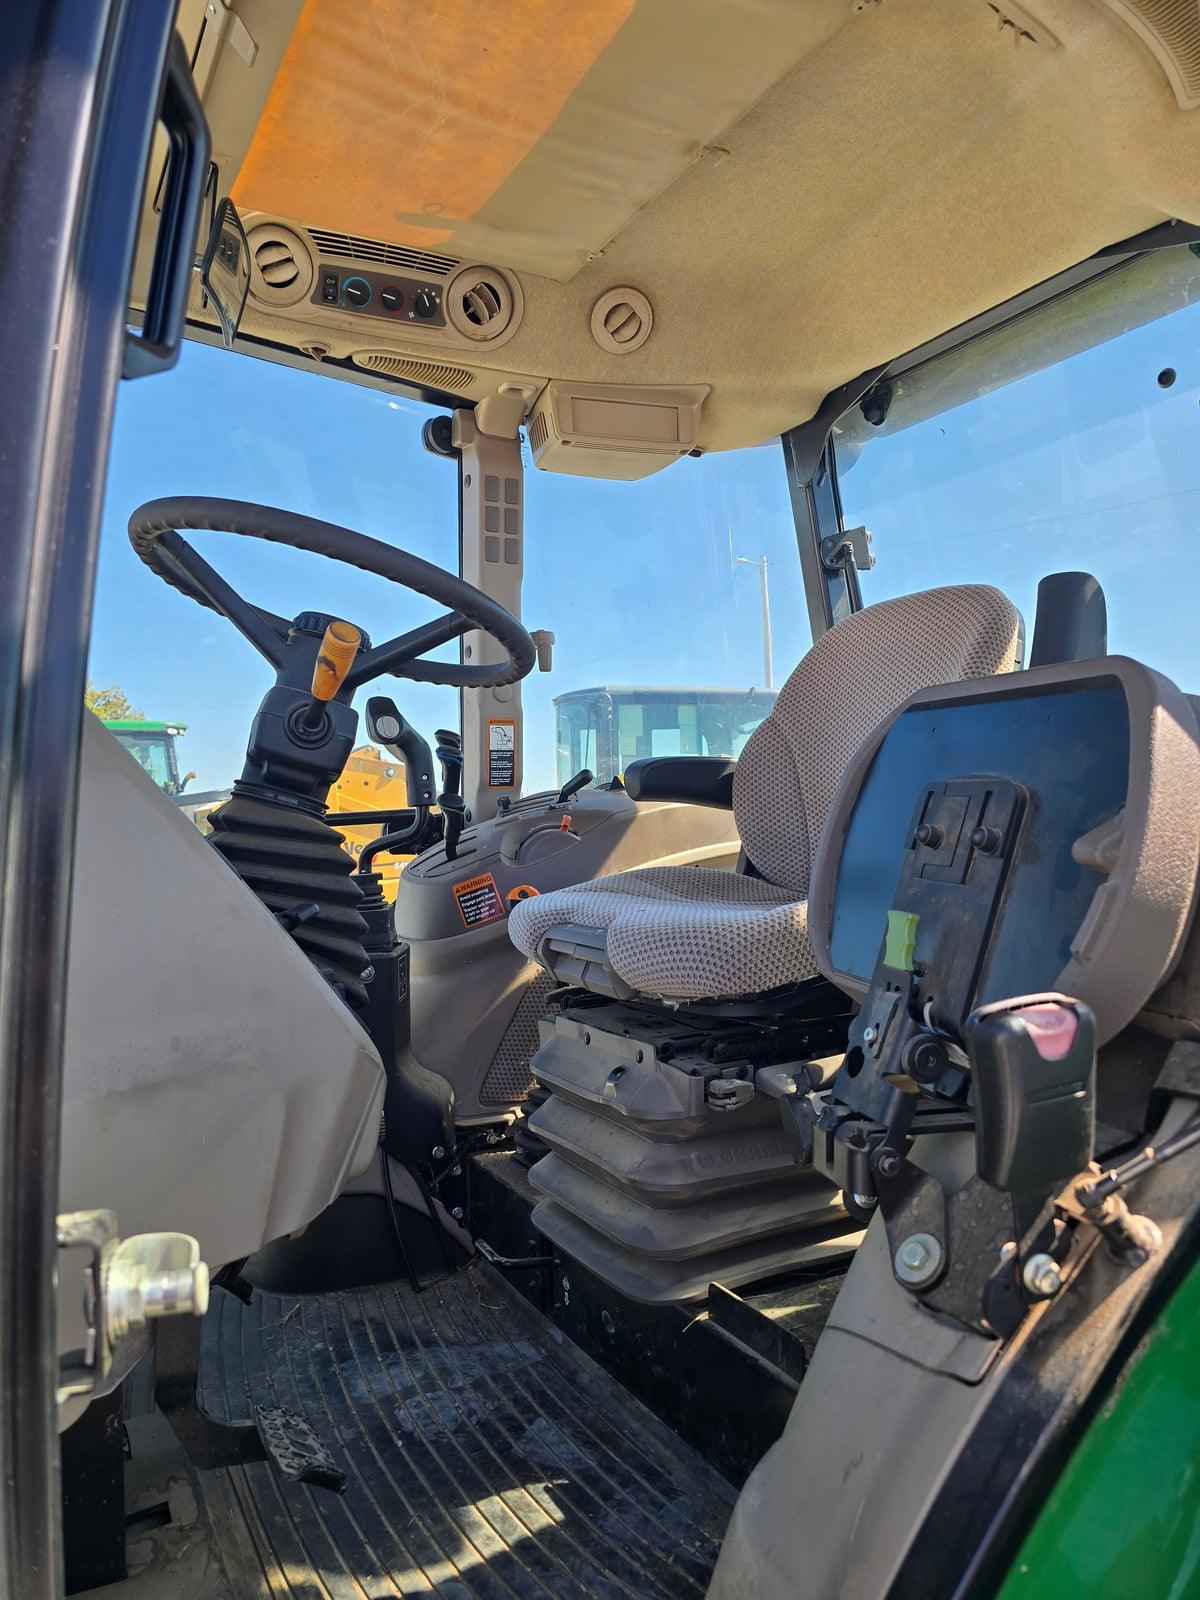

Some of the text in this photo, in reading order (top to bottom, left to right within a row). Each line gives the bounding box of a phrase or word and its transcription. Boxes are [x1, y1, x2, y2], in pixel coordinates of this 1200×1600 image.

[343, 841, 367, 856] Ve
[460, 876, 491, 890] WARNING
[472, 888, 488, 896] crushing
